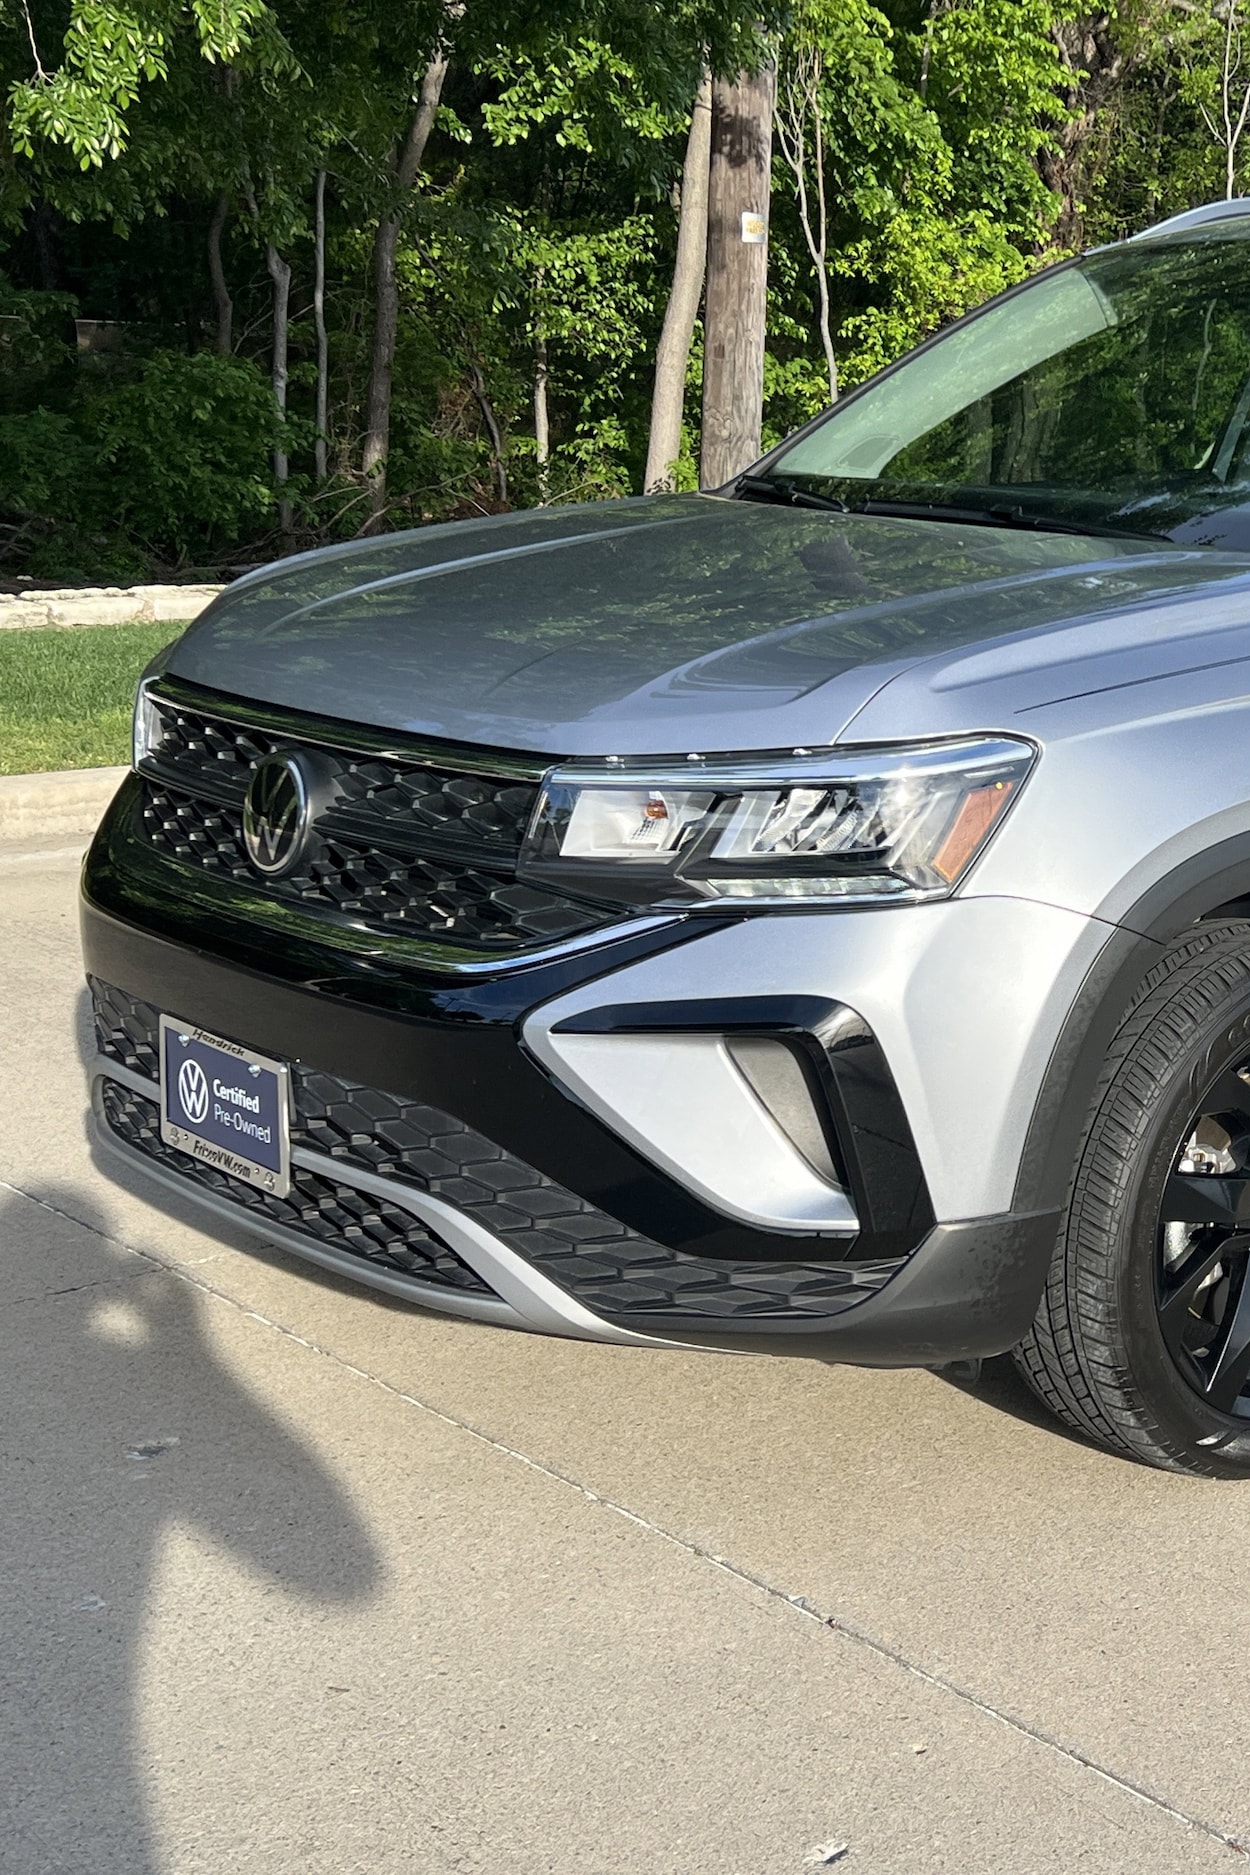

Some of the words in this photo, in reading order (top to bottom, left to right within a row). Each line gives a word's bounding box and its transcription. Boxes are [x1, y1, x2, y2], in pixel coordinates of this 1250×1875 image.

[192, 1028, 245, 1057] Hendrick
[178, 1059, 209, 1124] VW
[212, 1078, 260, 1114] Certified
[213, 1103, 271, 1144] Pre-Owned
